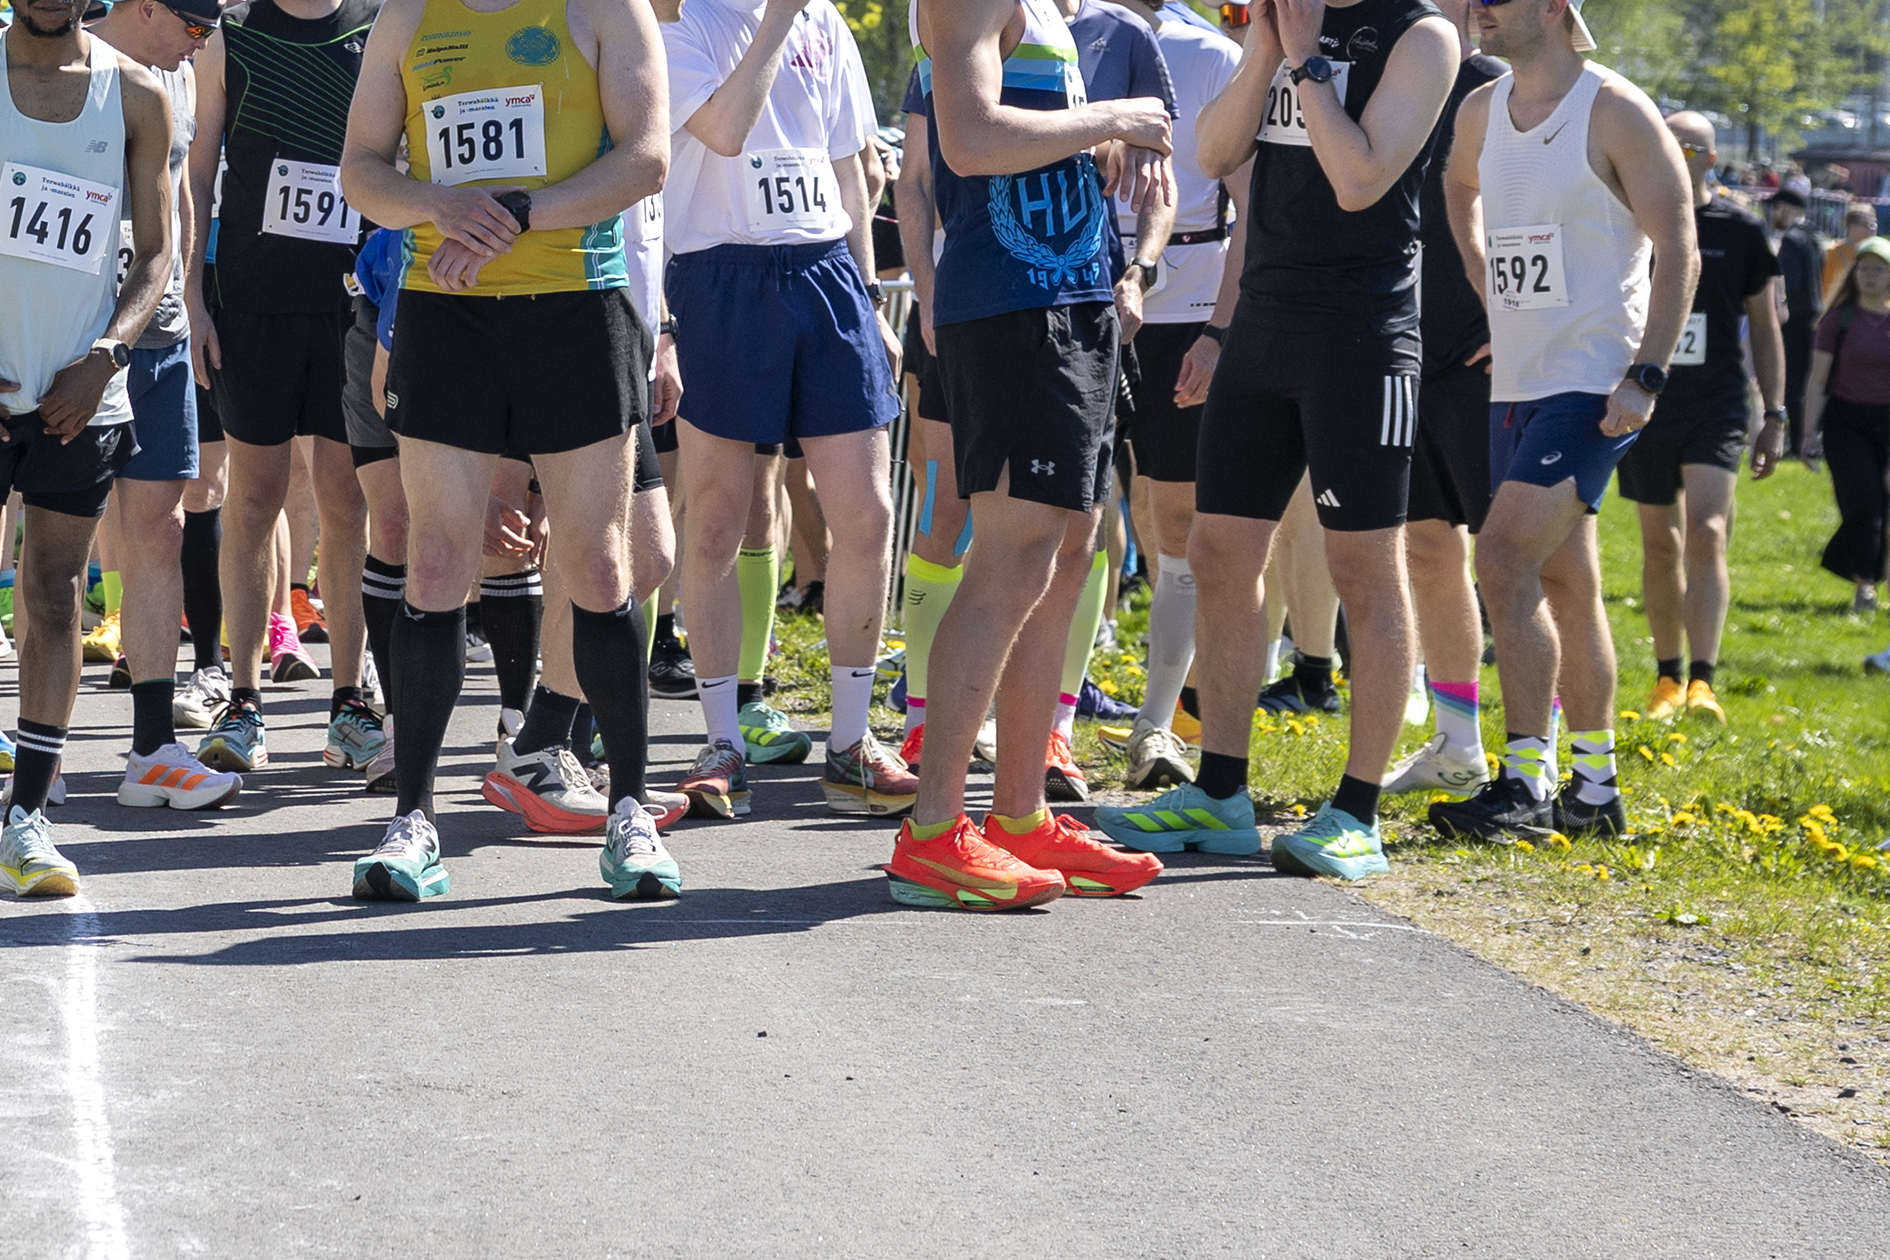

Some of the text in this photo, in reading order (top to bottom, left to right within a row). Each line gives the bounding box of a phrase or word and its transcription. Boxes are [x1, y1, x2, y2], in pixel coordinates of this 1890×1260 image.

[504, 95, 531, 107] ymca
[438, 117, 525, 169] 1581
[85, 189, 109, 203] ymca
[278, 185, 349, 229] 1591
[758, 176, 827, 215] 1514
[9, 195, 95, 256] 1416
[1490, 253, 1551, 296] 1592
